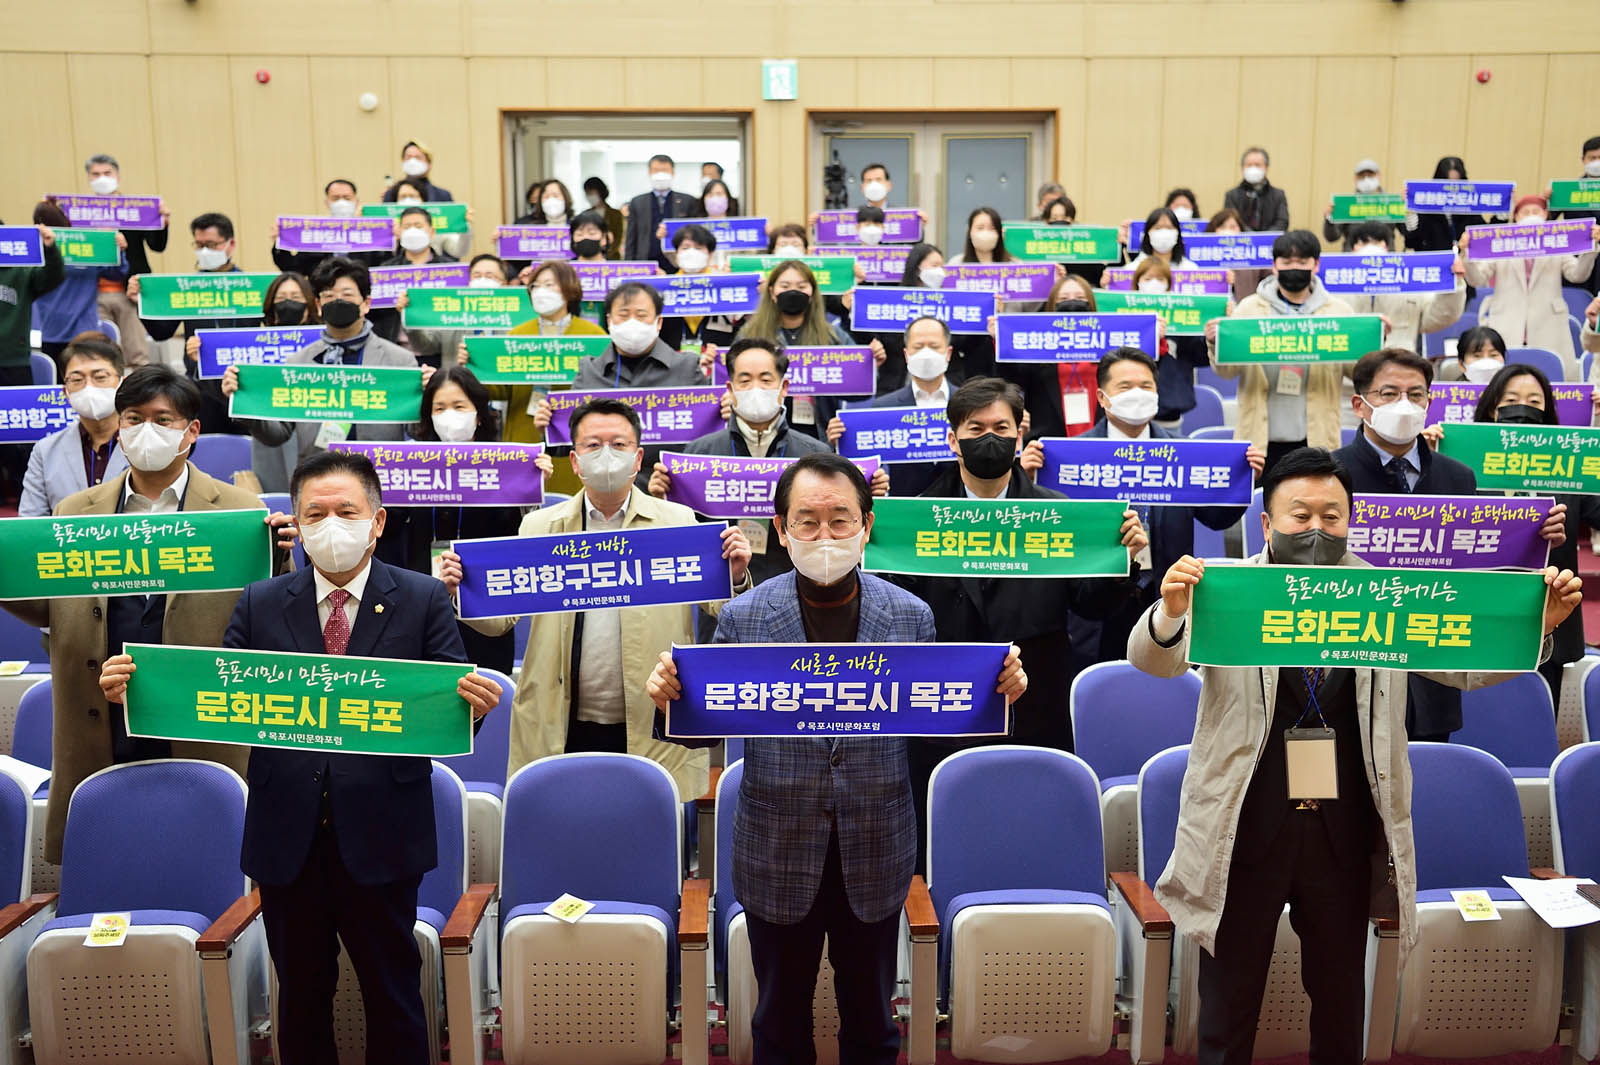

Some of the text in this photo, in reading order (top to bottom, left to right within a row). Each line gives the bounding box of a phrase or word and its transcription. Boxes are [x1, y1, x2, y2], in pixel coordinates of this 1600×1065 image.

[1570, 192, 1600, 203] 문화도
[580, 277, 606, 292] 도시
[1007, 278, 1032, 292] 목포
[1325, 267, 1440, 284] 문화항구도시 목포
[170, 291, 262, 308] 문화도시 목포
[659, 287, 748, 306] 항구도시 목포
[867, 304, 981, 322] 문화항구도시 목포
[1174, 310, 1200, 325] 목포
[1012, 332, 1140, 350] 문화항구도시 목포
[1250, 334, 1349, 354] 문화도시 목포
[216, 345, 301, 366] 문화항구도
[496, 356, 583, 372] 문화도시 목
[811, 367, 843, 384] 목포
[272, 388, 388, 410] 문화도시 목포
[645, 394, 666, 410] 삶이
[668, 392, 718, 408] 윤택해지는
[657, 410, 694, 430] 목포
[901, 411, 928, 426] 새로운
[1500, 430, 1552, 450] 목포시민이
[373, 447, 404, 466] 꽃피고
[408, 448, 440, 464] 시민의
[444, 447, 467, 466] 삶이
[471, 448, 528, 466] 윤택해지는
[1114, 444, 1178, 462] 새로운 개항,
[671, 459, 778, 478] 문화가 꽃피고 시민의
[1483, 452, 1600, 479] 문화도시 목
[458, 469, 500, 491] 목포
[1058, 464, 1230, 488] 문화항구도시 목포
[932, 504, 1062, 528] 목포시민이 만들어가는
[1353, 500, 1542, 526] 꽃피고 시민의 삶이 윤택해지는
[52, 520, 196, 548] 목포시민이 만들어가는
[1346, 526, 1502, 554] 문화도시 목포
[552, 536, 633, 559] 새로운 개항,
[916, 530, 1074, 558] 문화도시 목포
[36, 546, 214, 580] 문화도시 목포
[970, 560, 1029, 571] 목포시민문화포럼
[102, 579, 166, 589] 목포시민문화포럼
[486, 555, 702, 596] 문화항구도시 목포
[1285, 574, 1458, 607] 목포시민이 만들어가는
[571, 595, 630, 607] 목포시민문화포럼
[1261, 609, 1472, 648] 문화도시 목포
[790, 652, 892, 677] 새로운 개항,
[1331, 650, 1408, 664] 목포시민문화포럼
[216, 657, 386, 692] 목포시민이 만들어가는
[704, 682, 974, 713] 문화항구도시 목포
[196, 691, 402, 733] 문화도시 목포
[807, 721, 880, 732] 목포시민문화포럼
[268, 732, 342, 746] 목포시민문화포럼
